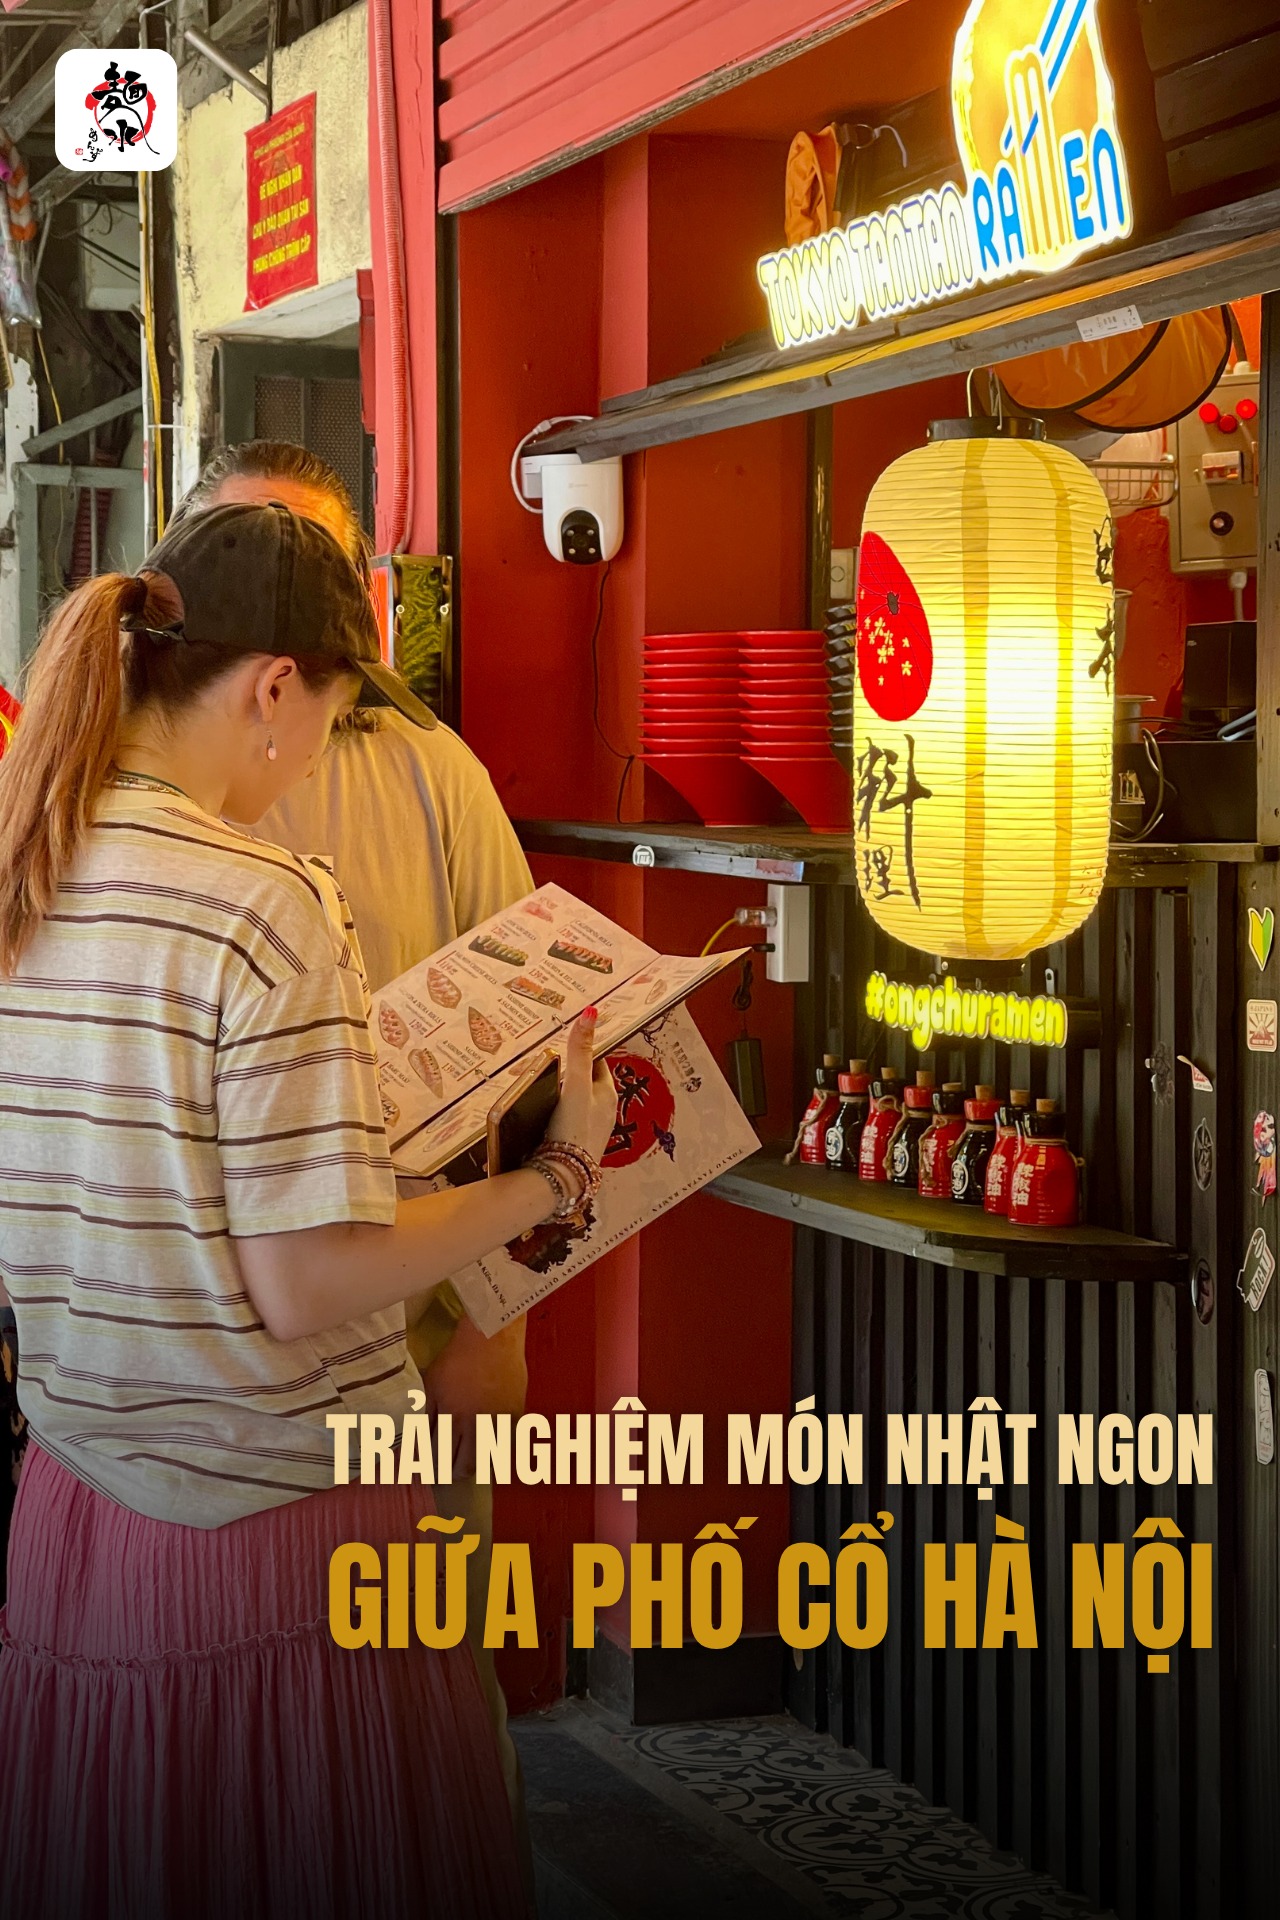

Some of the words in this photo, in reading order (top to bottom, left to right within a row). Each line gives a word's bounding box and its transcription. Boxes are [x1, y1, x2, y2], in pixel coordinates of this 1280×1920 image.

[760, 231, 855, 348] TOKYO
[849, 186, 974, 318] TANTAN
[856, 733, 933, 913] 料理
[866, 970, 1067, 1051] #ongchuramen
